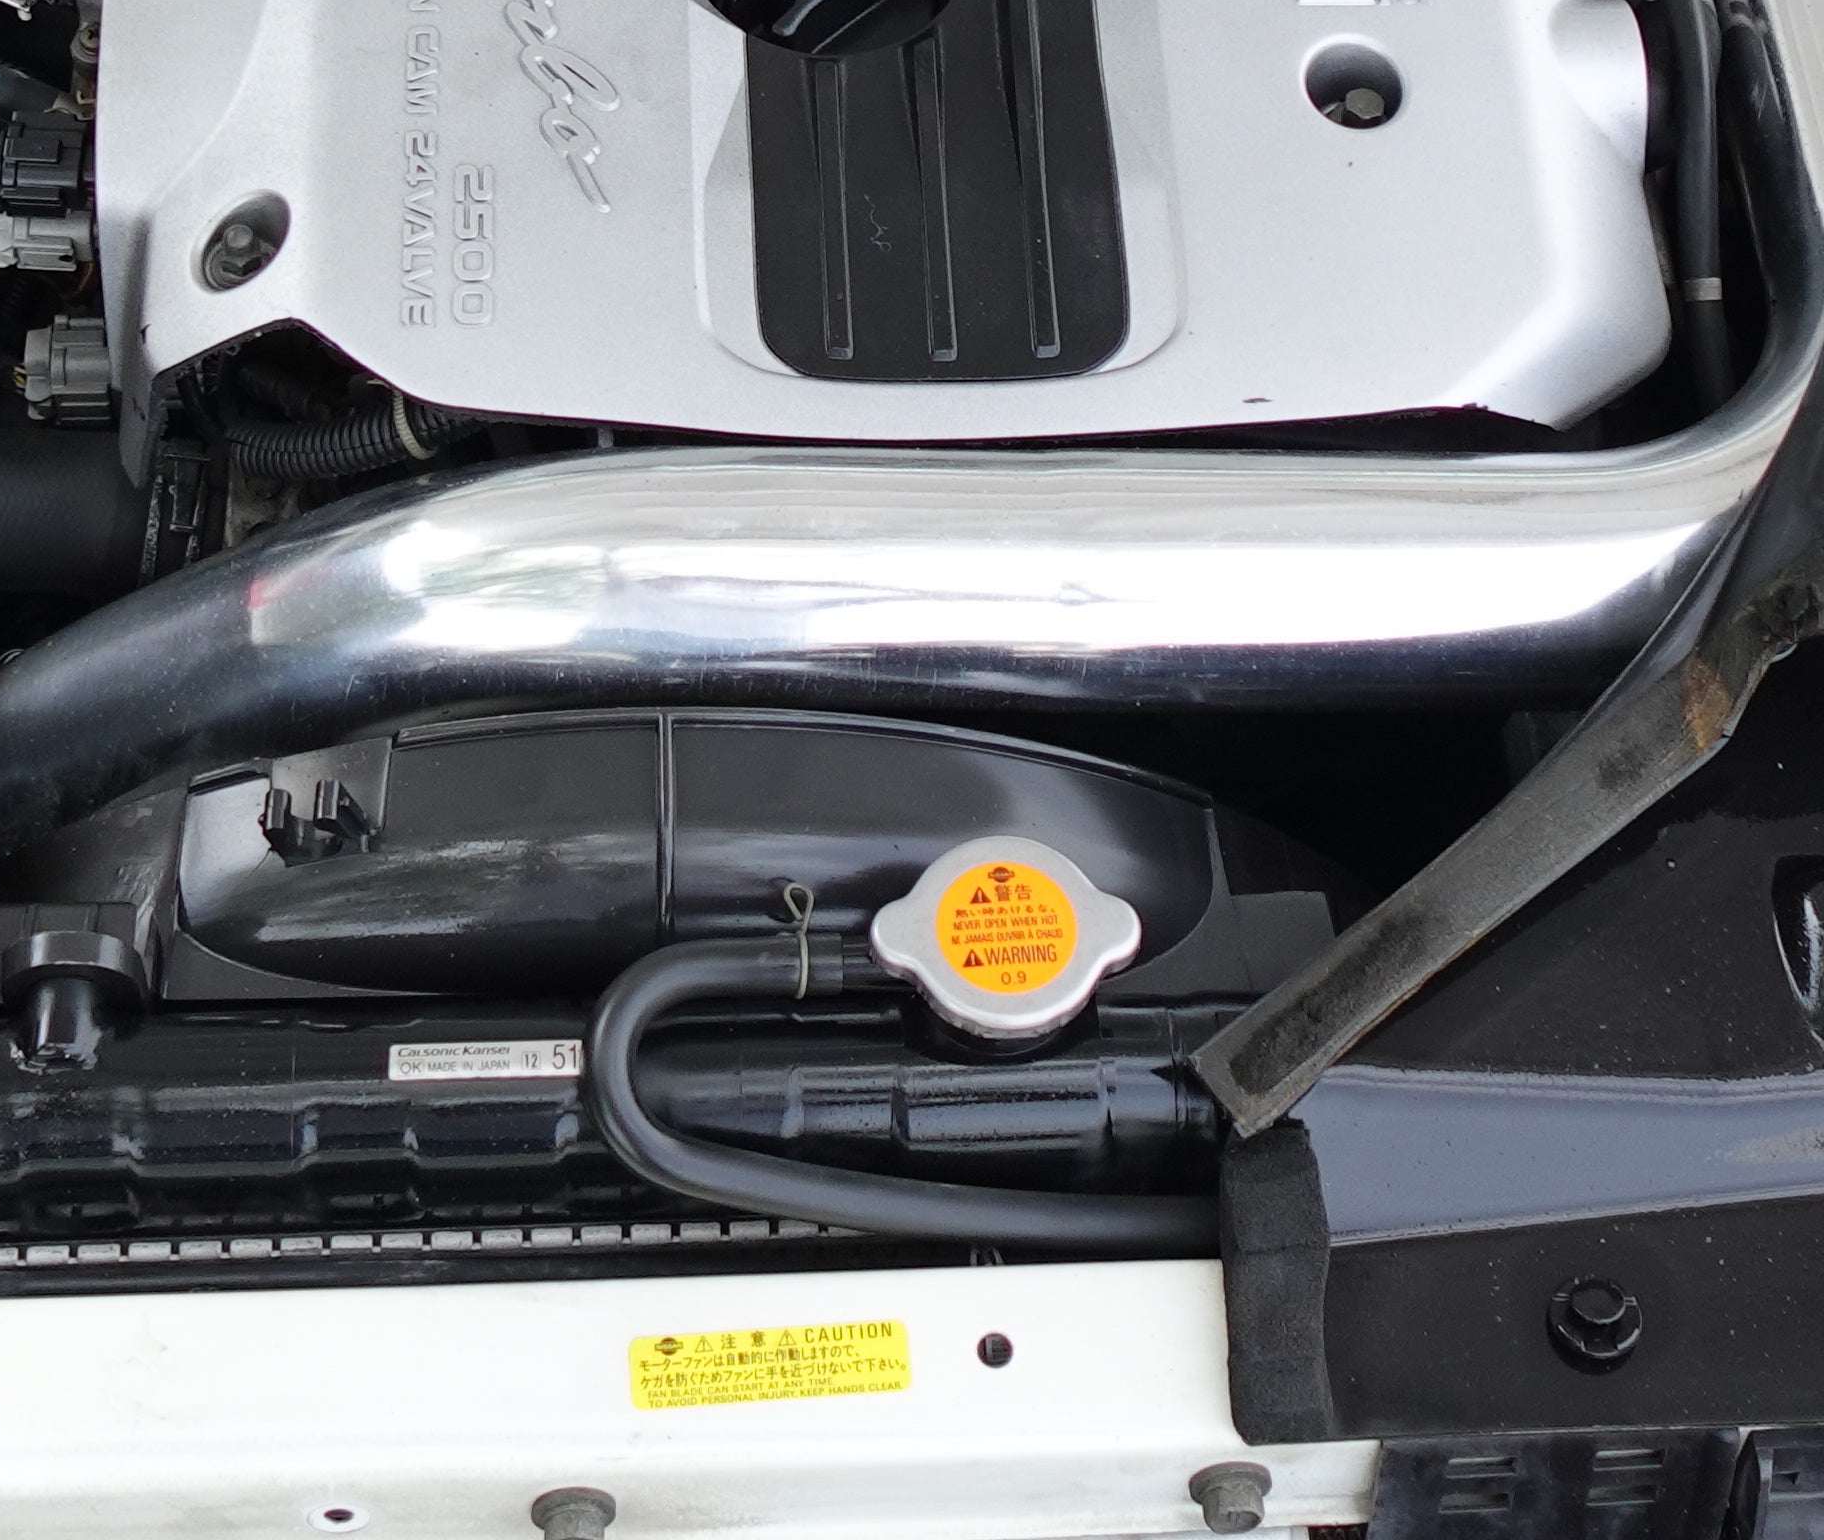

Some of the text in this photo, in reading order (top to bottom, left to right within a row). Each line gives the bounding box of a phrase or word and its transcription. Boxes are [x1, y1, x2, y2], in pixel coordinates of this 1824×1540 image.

[405, 24, 441, 116] CAM
[451, 162, 495, 328] 2500
[993, 884, 1032, 902] 警告
[953, 914, 1058, 931] NEVER OPEN WHEN HOT
[984, 943, 1058, 966] WARNING
[462, 1045, 511, 1056] Kansei
[524, 1053, 539, 1069] 12
[399, 1060, 511, 1075] OK MADE IN JAPAN
[804, 1322, 893, 1344] CAUTION
[648, 1389, 667, 1399] FAN
[671, 1386, 703, 1397] BLADE
[707, 1385, 729, 1395] CAN
[733, 1383, 763, 1393] START
[768, 1380, 780, 1390] AT
[784, 1378, 804, 1388] ANY
[649, 1384, 865, 1408] TO AVOID PERSONAL KEEP HANDS
